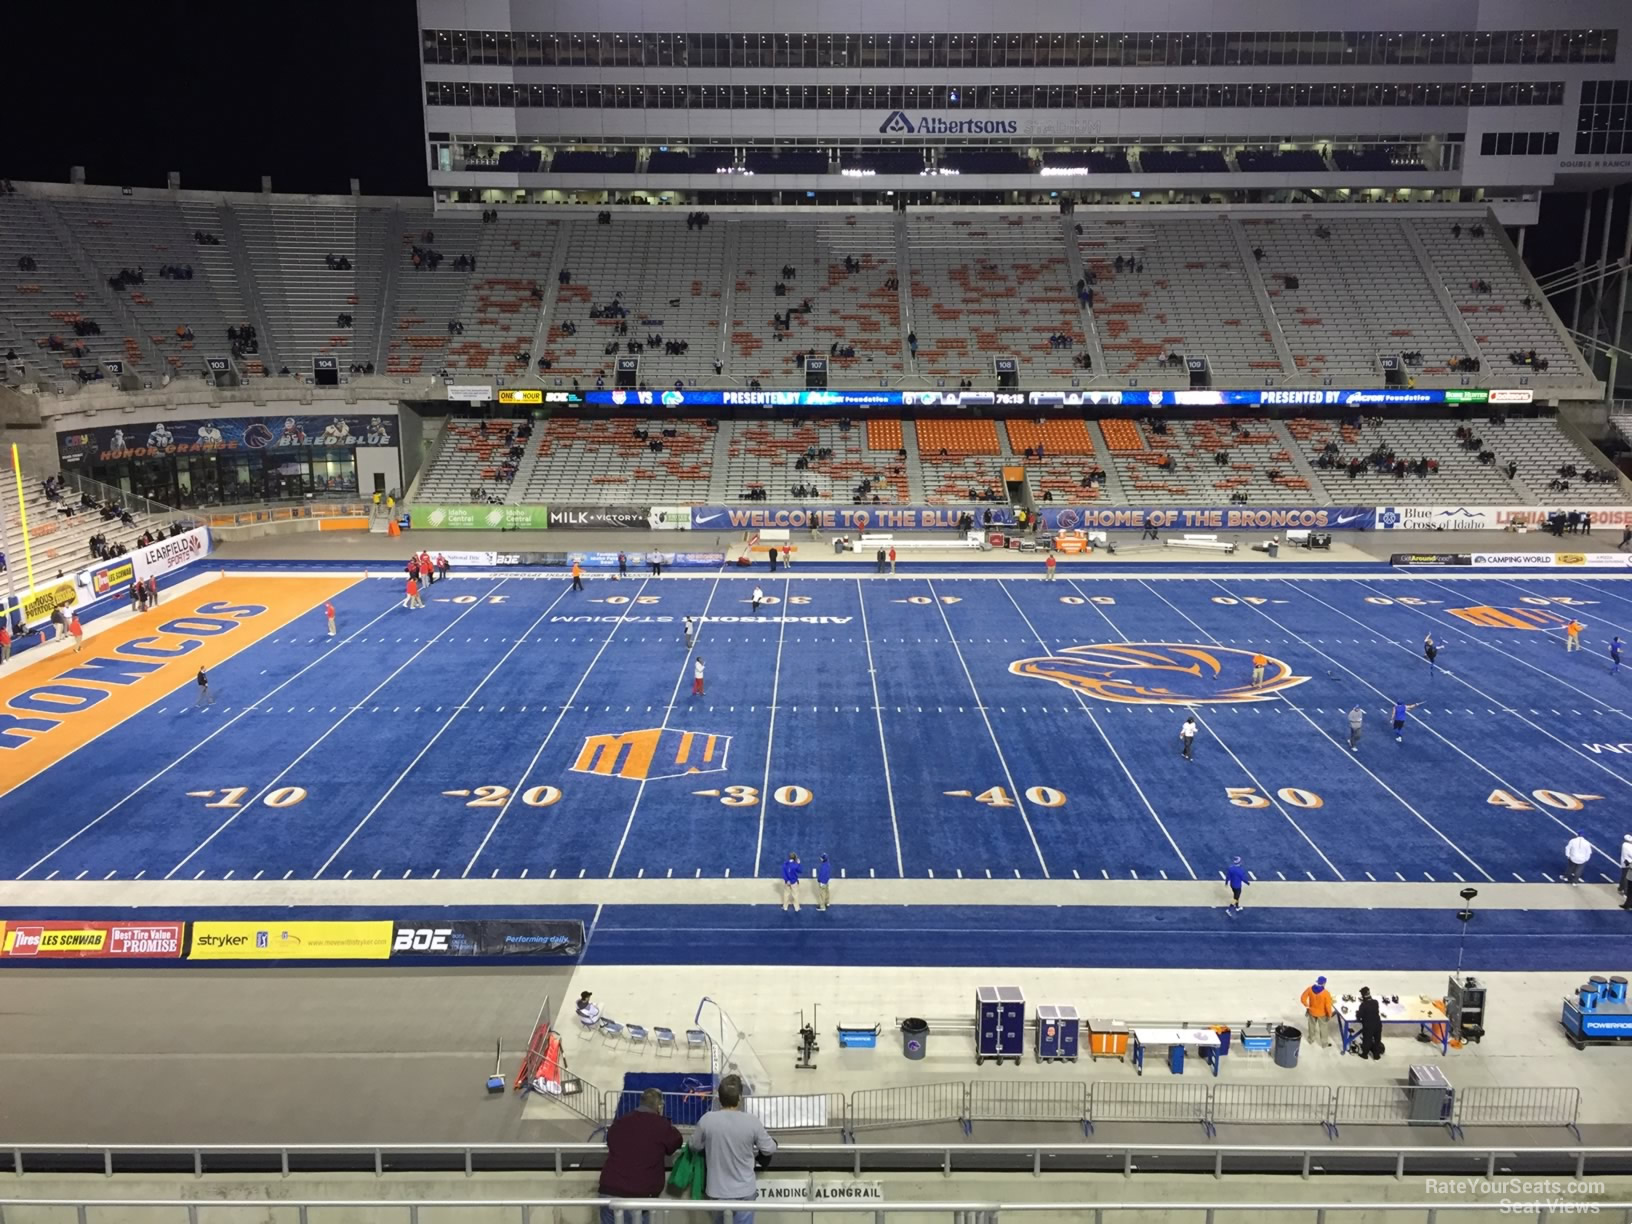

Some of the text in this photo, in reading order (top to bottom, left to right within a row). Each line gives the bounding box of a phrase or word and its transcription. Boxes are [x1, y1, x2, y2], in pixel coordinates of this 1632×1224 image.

[917, 117, 1018, 134] Albertsons
[105, 363, 119, 372] 02
[211, 360, 225, 370] 103
[318, 360, 332, 368] 104
[637, 391, 653, 404] VS
[996, 394, 1025, 404] 76:15
[1260, 391, 1341, 404] PRESENTED BY
[278, 436, 338, 447] BLEED
[344, 435, 391, 445] BLUE
[550, 512, 588, 524] MILK
[728, 510, 836, 527] WELCOME
[841, 510, 870, 527] TO
[875, 510, 916, 527] THE
[1084, 510, 1329, 527] HOME OF THE BRONCOS
[1404, 507, 1432, 518] Blue
[1403, 519, 1485, 530] Cross of Idaho
[145, 538, 189, 565] LEARFIELD
[167, 550, 191, 568] SPORTS
[496, 555, 521, 564] BOE
[1488, 556, 1522, 564] CAMPING
[550, 615, 853, 624] Albertsons STADIUM
[15, 931, 103, 948] Tires LES SCHWAB
[115, 929, 171, 940] Best Tire Value
[393, 929, 453, 950] BOE
[505, 935, 548, 943] Performing
[122, 939, 178, 953] PROMISE
[197, 934, 248, 948] stryker
